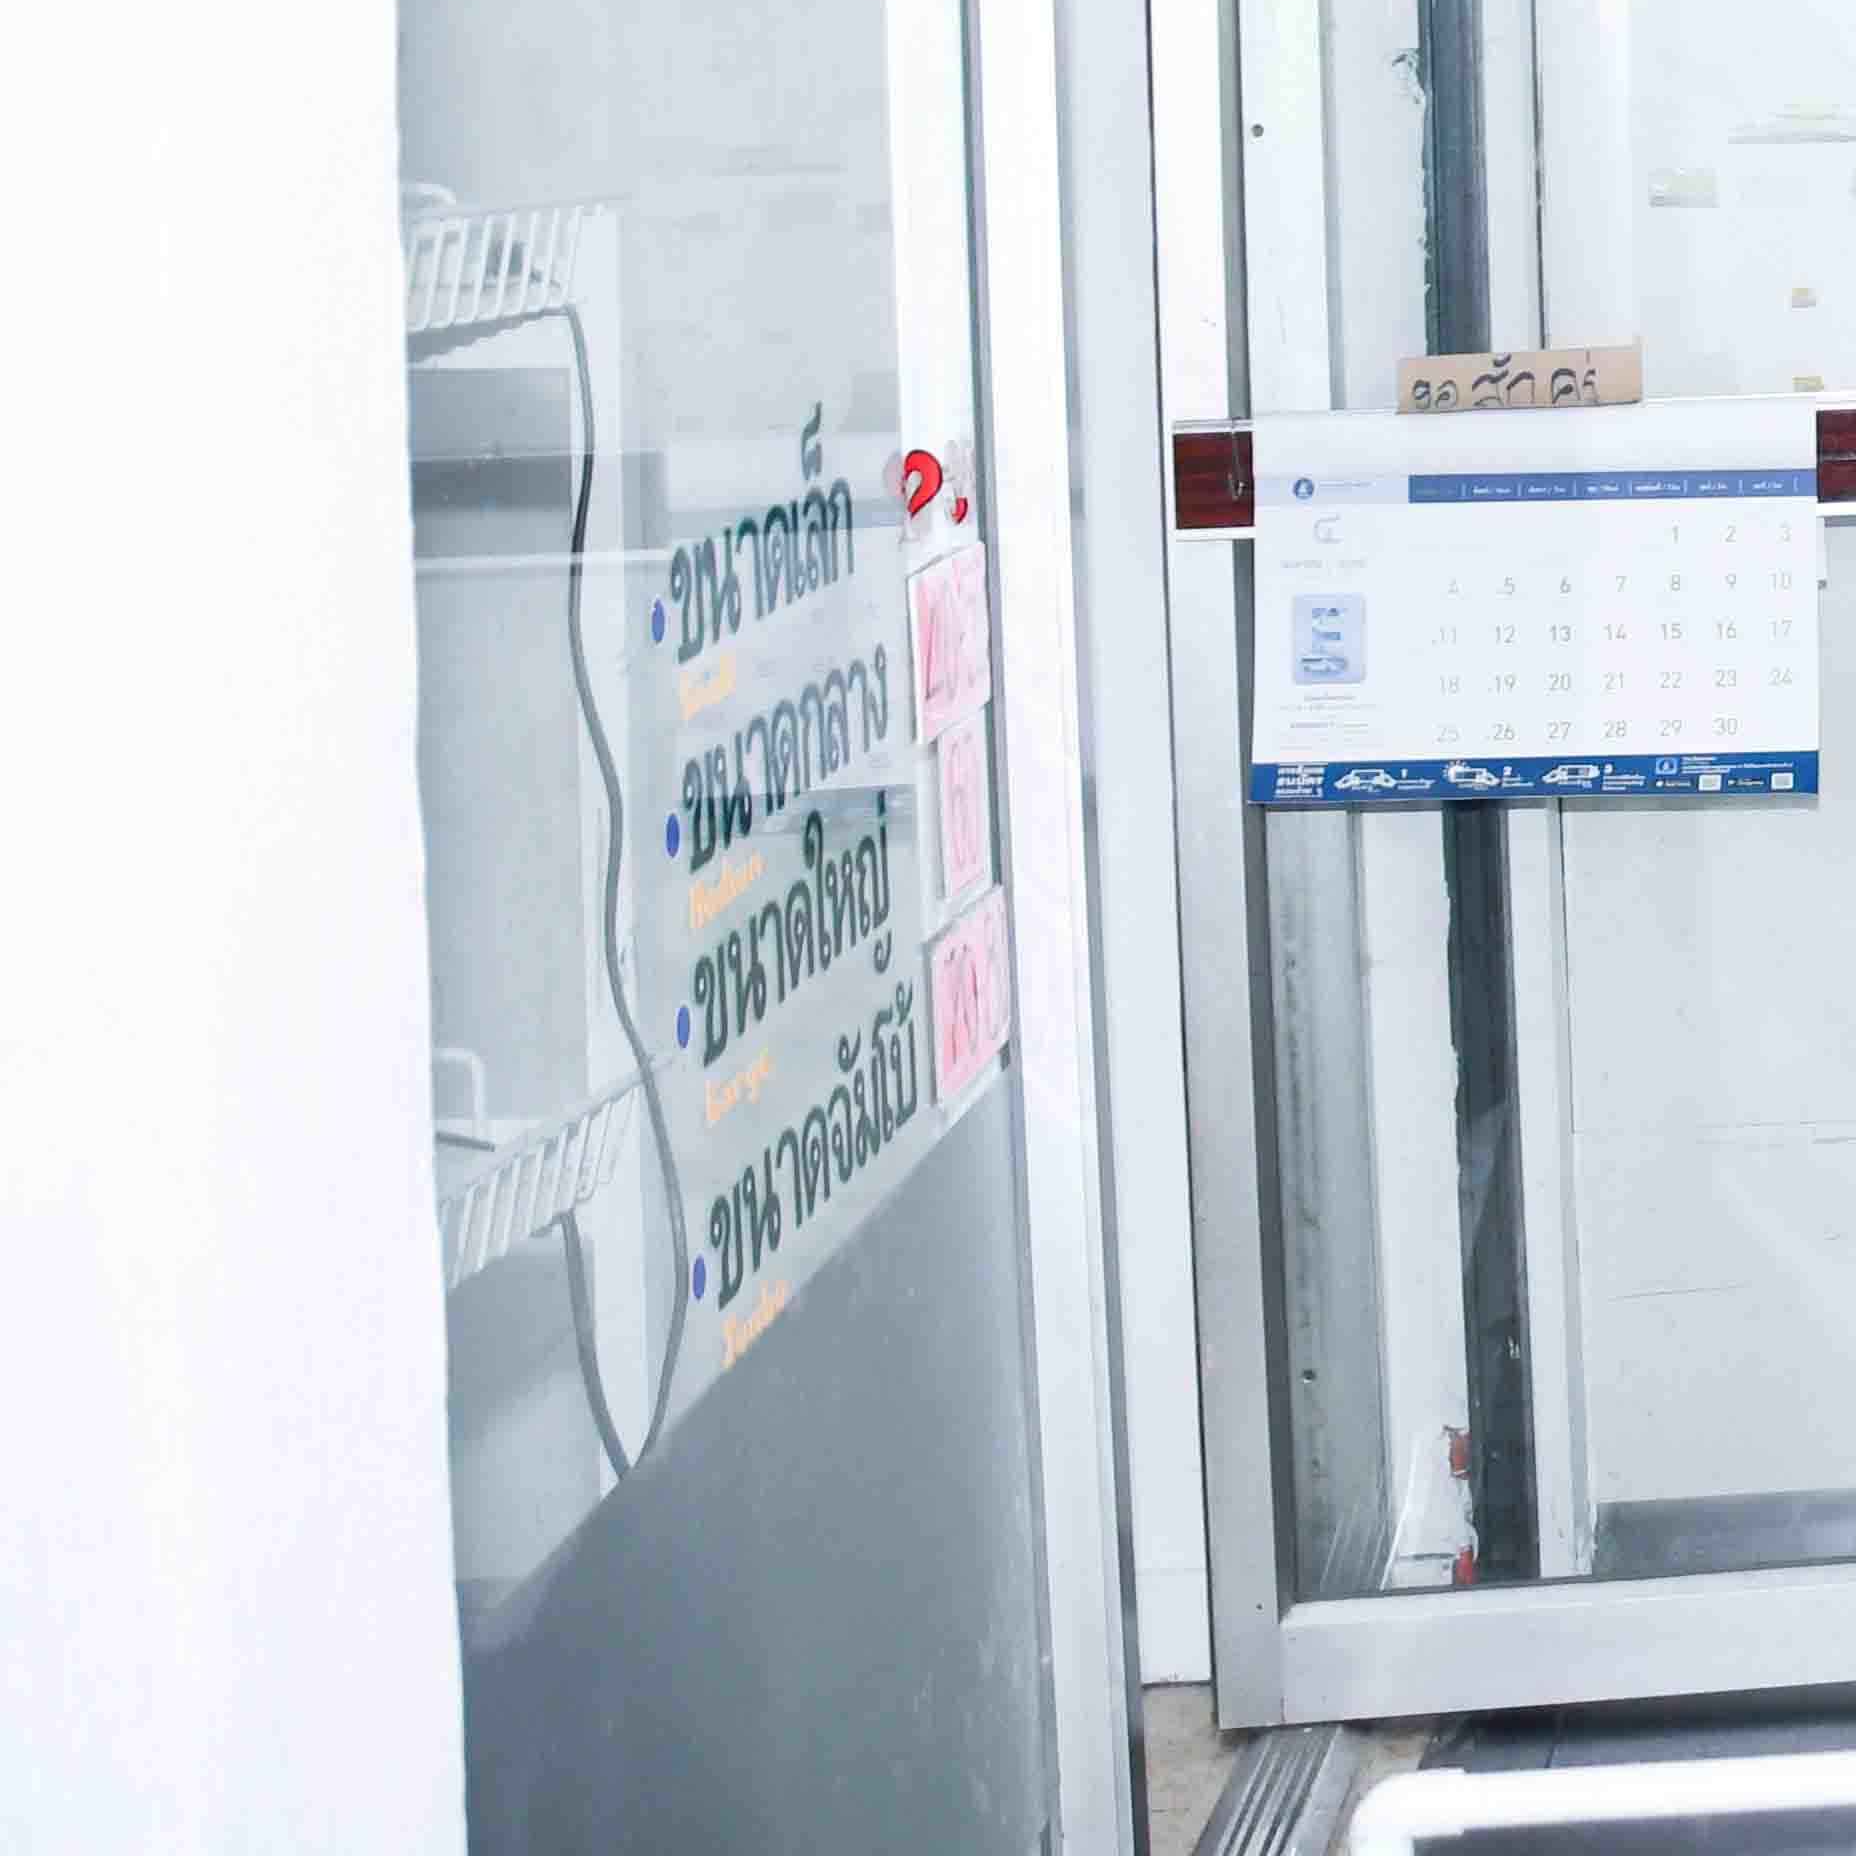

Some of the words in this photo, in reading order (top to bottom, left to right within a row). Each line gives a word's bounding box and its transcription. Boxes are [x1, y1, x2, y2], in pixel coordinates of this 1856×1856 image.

[670, 401, 854, 664] ขนาดเล็ก
[1671, 525, 1680, 543] 1
[1725, 525, 1737, 543] 2
[1780, 523, 1792, 542] 3
[1502, 577, 1515, 596] 5
[1560, 576, 1572, 595] 6
[1615, 576, 1628, 593] 7
[1670, 574, 1681, 592] 8
[1725, 573, 1737, 591] 9
[1771, 571, 1793, 590] 10
[1495, 624, 1517, 645] 12
[1549, 624, 1573, 643] 13
[1604, 623, 1628, 641] 14
[1661, 622, 1683, 641] 15
[1716, 621, 1738, 640] 16
[1770, 619, 1793, 638] 17
[1494, 674, 1517, 693] 19
[1547, 672, 1572, 692] 20
[1604, 671, 1626, 691] 21
[1659, 670, 1683, 689] 22
[1715, 668, 1738, 688] 23
[1493, 723, 1517, 743] 26
[1548, 721, 1573, 741] 27
[1604, 719, 1629, 739] 28
[1659, 719, 1684, 738] 29
[1713, 717, 1738, 737] 30
[683, 643, 888, 874] ขนาดกลาง
[694, 790, 892, 1067] ขนาดใหญ่
[710, 979, 918, 1312] ขนาดจัมโบ้
